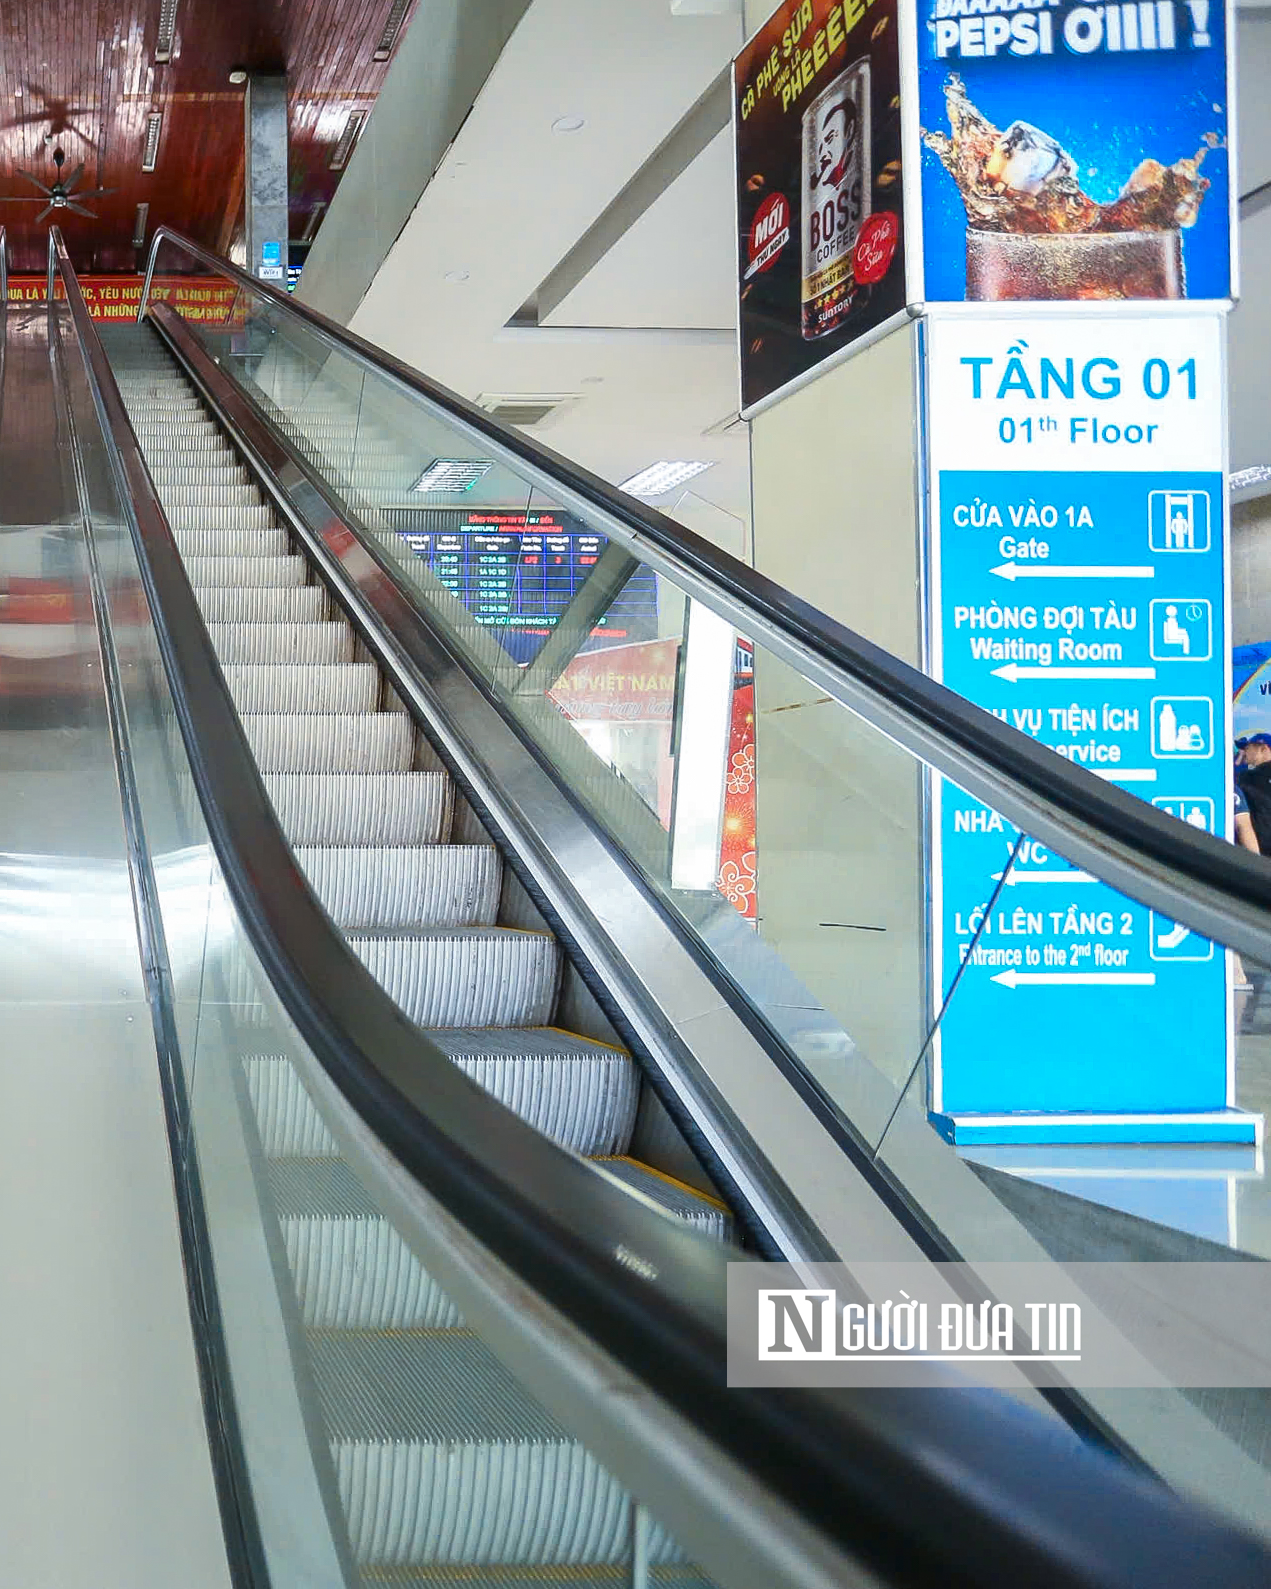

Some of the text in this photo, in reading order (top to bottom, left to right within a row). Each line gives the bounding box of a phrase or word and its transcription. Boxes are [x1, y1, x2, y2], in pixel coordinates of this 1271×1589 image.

[935, 11, 1054, 58] PEPSI
[754, 196, 784, 249] MỚI
[810, 179, 862, 252] BOSS
[816, 225, 855, 263] COFFEE
[818, 294, 854, 323] SUNTORY
[960, 339, 1197, 400] TẦNG 01
[1070, 417, 1159, 444] Floor
[952, 497, 1094, 528] CỬA VÀO 1A
[998, 536, 1050, 559] Gate
[954, 599, 1137, 635] PHÒNG ĐỢI TÀU
[970, 637, 1123, 666] Waiting Room
[631, 673, 674, 691] NAM
[1012, 708, 1042, 737] VỤ
[1048, 702, 1096, 737] TIỆN
[1102, 702, 1140, 731] ÍCH
[1046, 739, 1121, 763] ervice
[1006, 841, 1048, 864] WC
[955, 902, 1134, 935] LỐI LÊN TẦNG 2
[1025, 944, 1040, 966] to
[1043, 943, 1067, 966] the
[1069, 942, 1091, 966] 2nd
[1093, 943, 1129, 966] floor
